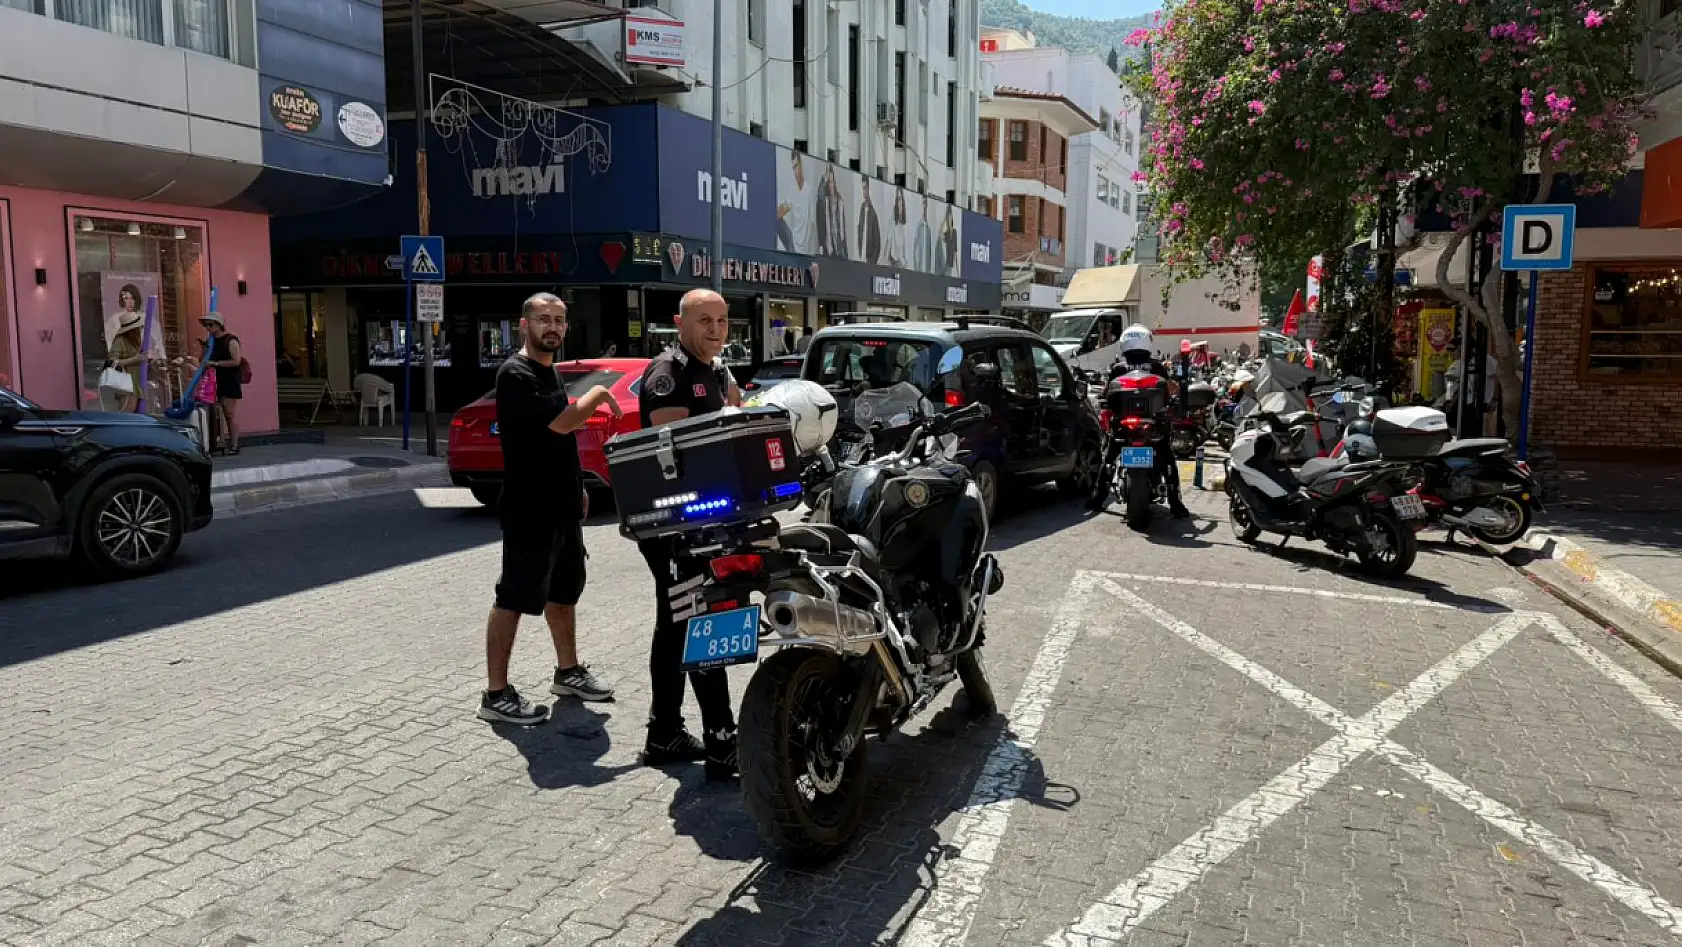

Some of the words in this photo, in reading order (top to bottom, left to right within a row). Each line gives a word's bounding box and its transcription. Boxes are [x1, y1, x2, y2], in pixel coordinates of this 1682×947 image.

[637, 30, 660, 42] KMS
[472, 155, 564, 197] mavi
[697, 169, 748, 211] mavi
[1522, 220, 1553, 255] D
[970, 239, 990, 263] mavi
[745, 261, 805, 287] JEWELLERY
[873, 272, 900, 296] mavi
[946, 283, 968, 303] mavi
[768, 442, 782, 458] 112
[692, 620, 713, 638] 48
[743, 612, 753, 630] A
[708, 634, 752, 656] 8350
